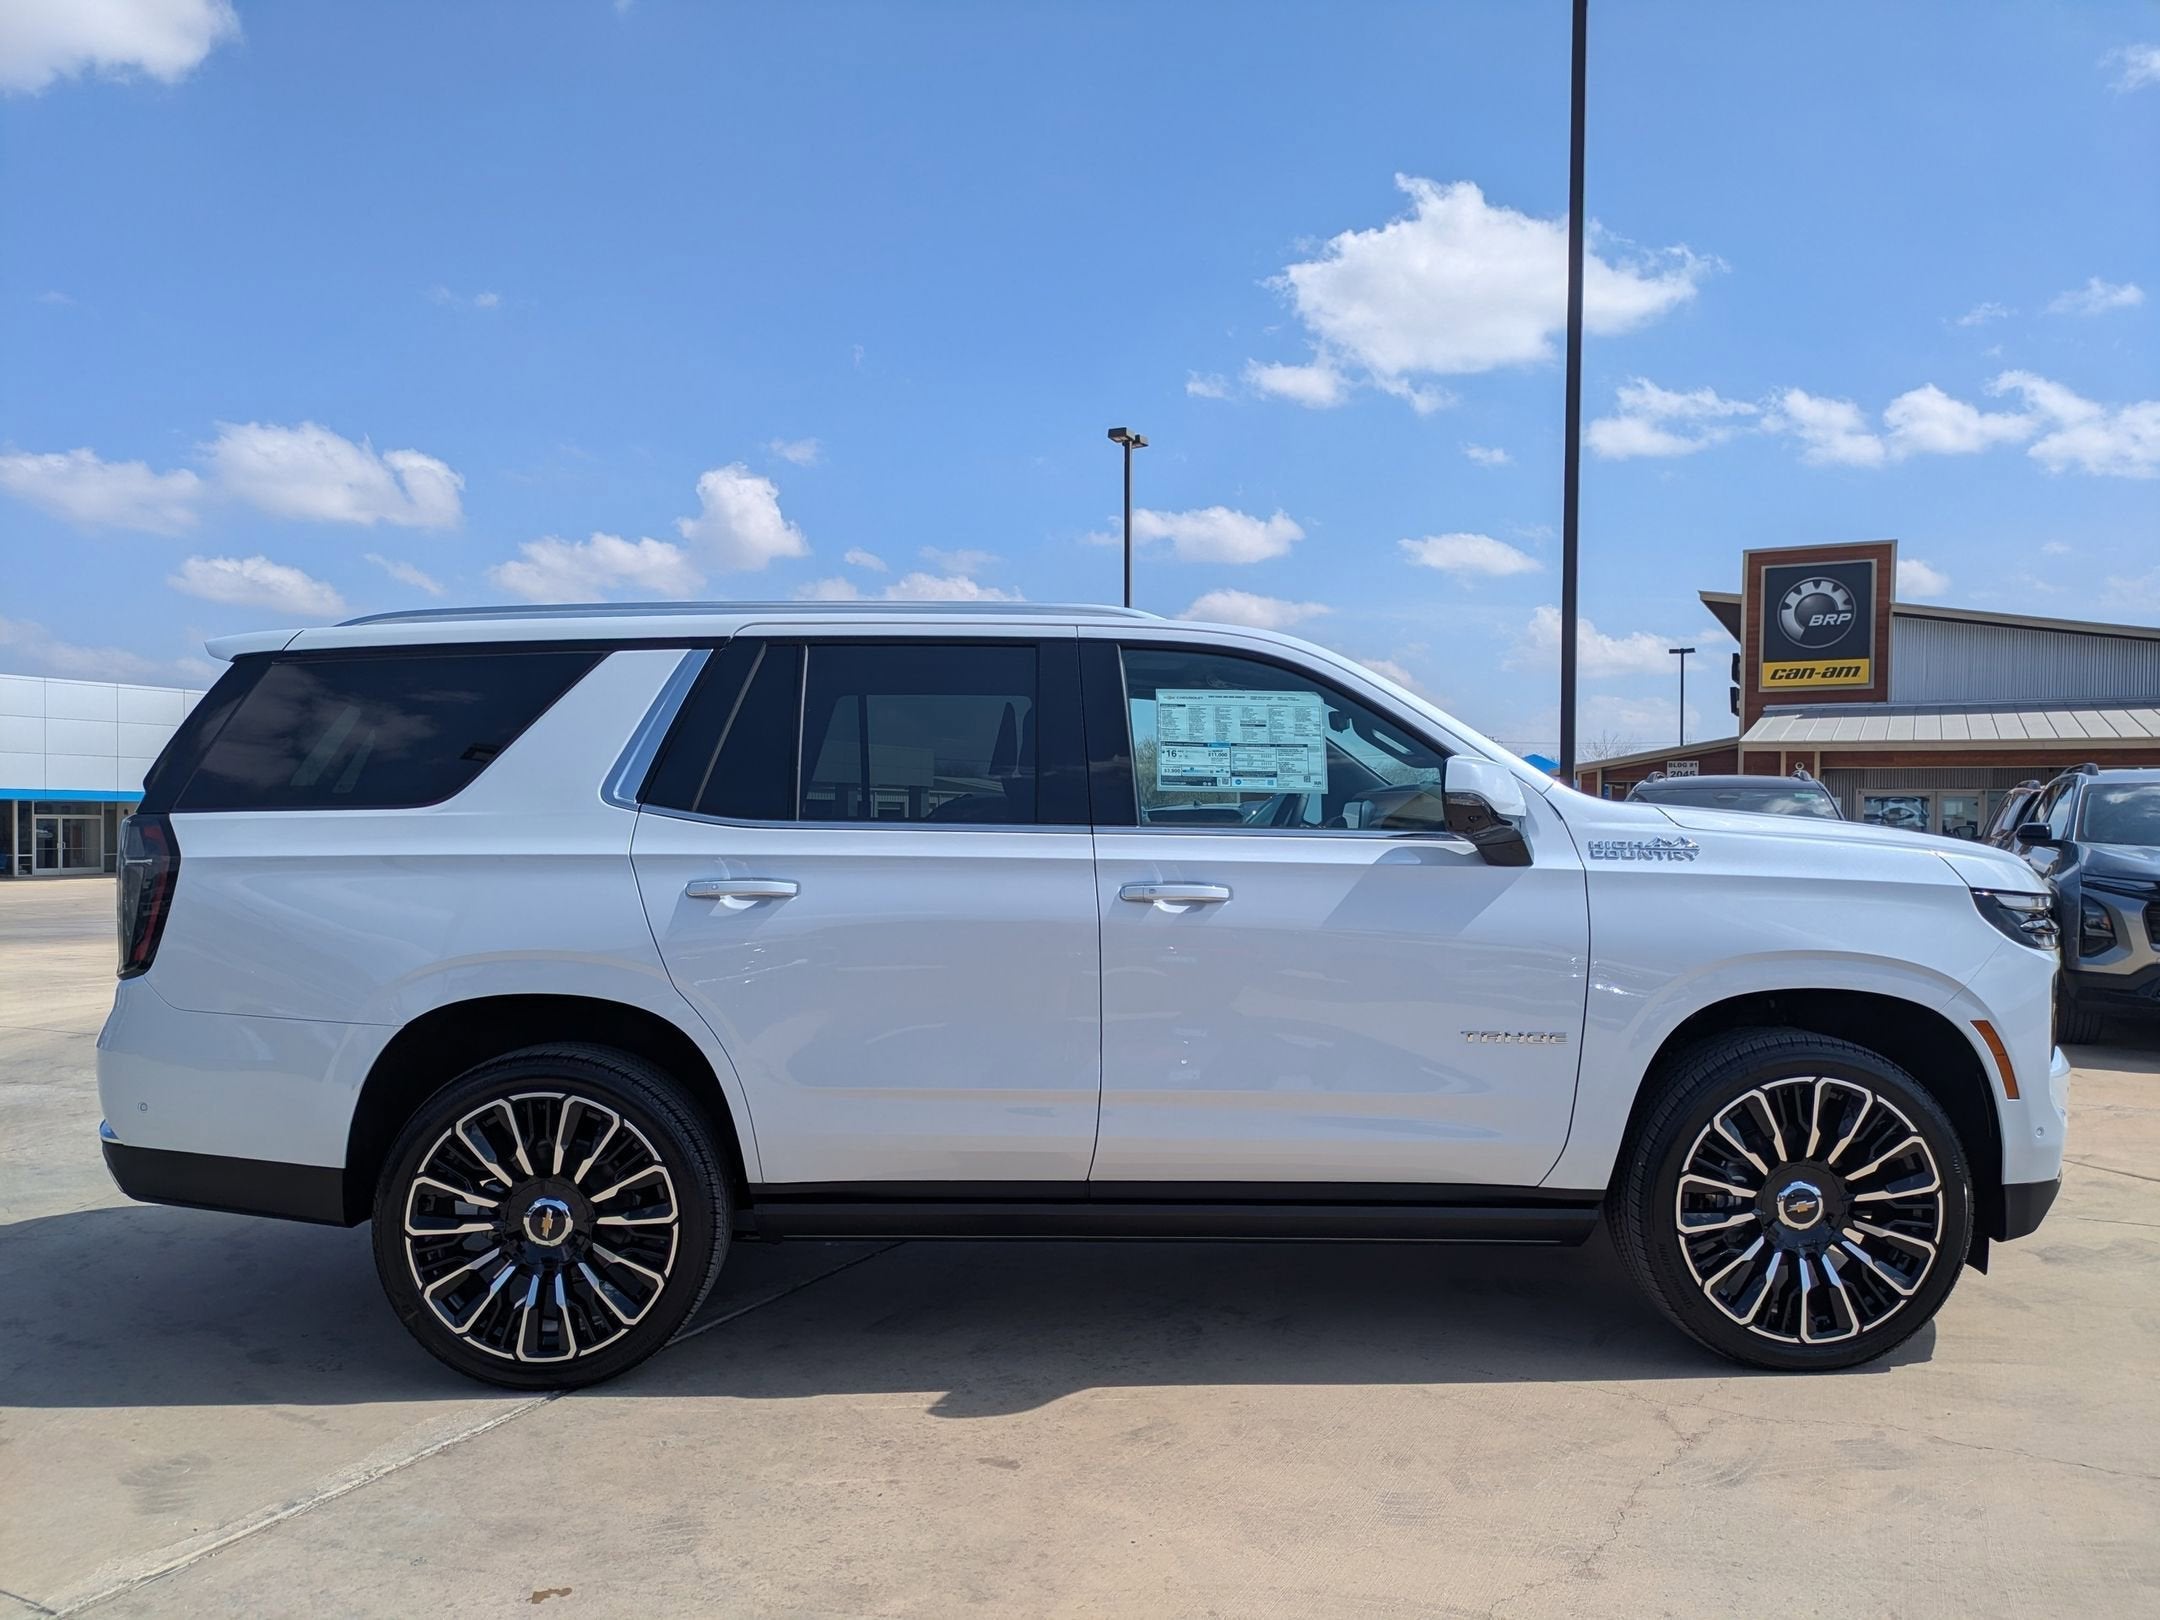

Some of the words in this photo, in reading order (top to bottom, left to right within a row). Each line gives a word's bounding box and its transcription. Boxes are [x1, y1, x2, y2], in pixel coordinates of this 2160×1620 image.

[1808, 613, 1852, 627] BRP
[1770, 665, 1861, 680] can-am
[1166, 749, 1178, 758] 16
[1670, 770, 1696, 778] 2045
[1588, 840, 1643, 850] HIGH
[1589, 849, 1699, 861] COUNTRY
[1460, 1031, 1568, 1043] TAHOE
